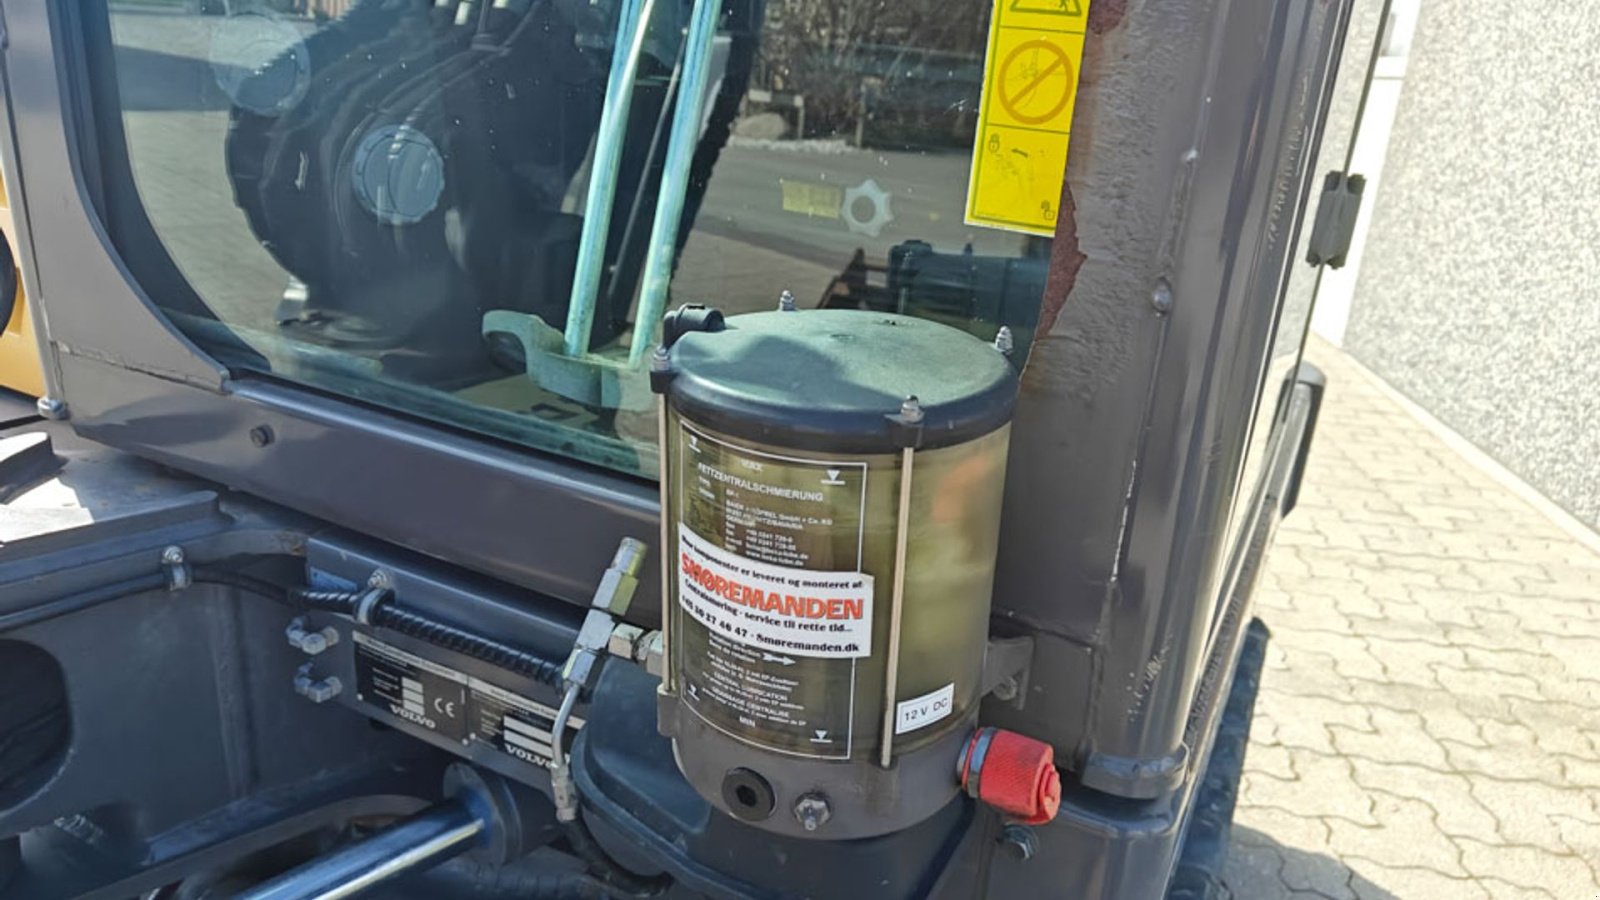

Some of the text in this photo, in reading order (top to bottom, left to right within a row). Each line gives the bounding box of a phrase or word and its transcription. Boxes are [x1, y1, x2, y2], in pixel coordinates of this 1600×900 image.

[698, 462, 823, 502] FETTZENTRALSCHMIERUNG
[682, 552, 863, 620] SMØREMANDEN
[741, 568, 750, 576] er
[752, 571, 785, 585] leveret
[788, 579, 800, 588] og
[802, 580, 849, 589] monteret
[745, 612, 781, 627] service
[784, 620, 796, 629] til
[798, 623, 826, 632] rette
[735, 627, 748, 638] 47
[756, 633, 859, 652] Smøremanden.dk
[389, 703, 436, 729] VOLVO
[905, 697, 948, 720] 12 V DC
